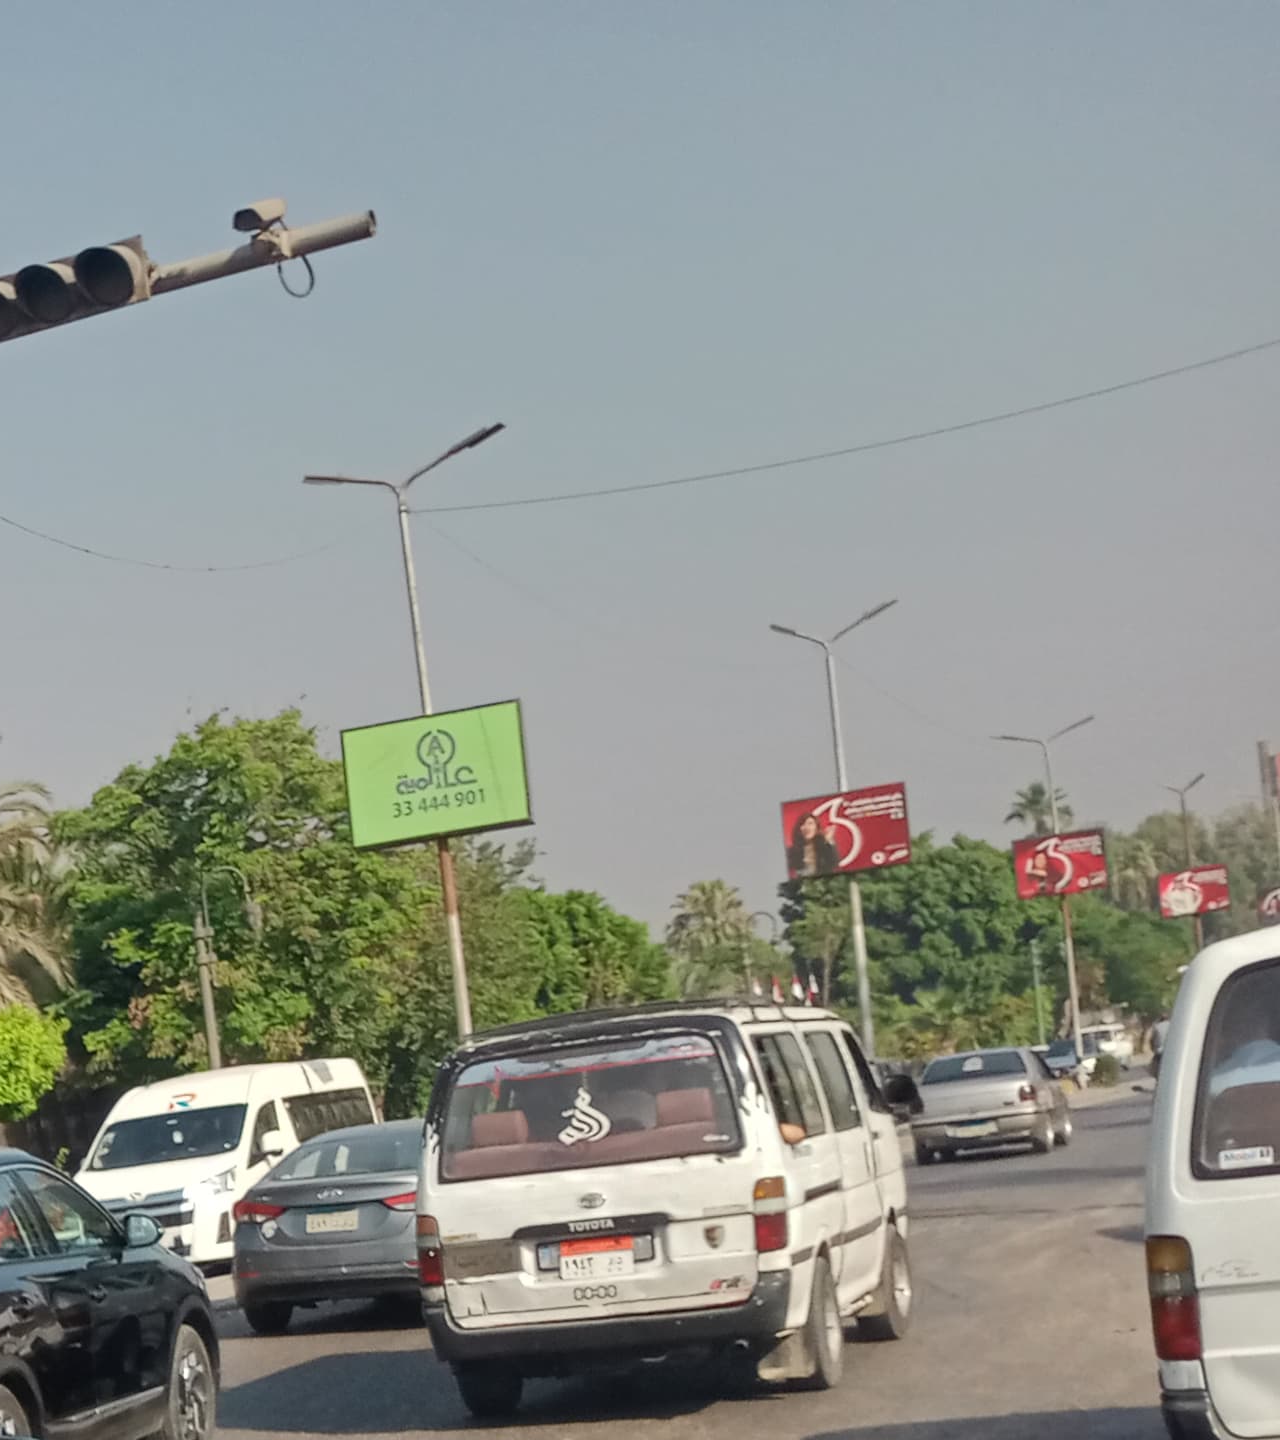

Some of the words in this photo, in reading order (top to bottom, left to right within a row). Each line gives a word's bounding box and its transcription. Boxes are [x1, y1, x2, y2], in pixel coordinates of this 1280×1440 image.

[392, 801, 413, 818] 33
[418, 793, 450, 813] 444
[454, 788, 485, 808] 901
[568, 1218, 615, 1232] TOYOTA
